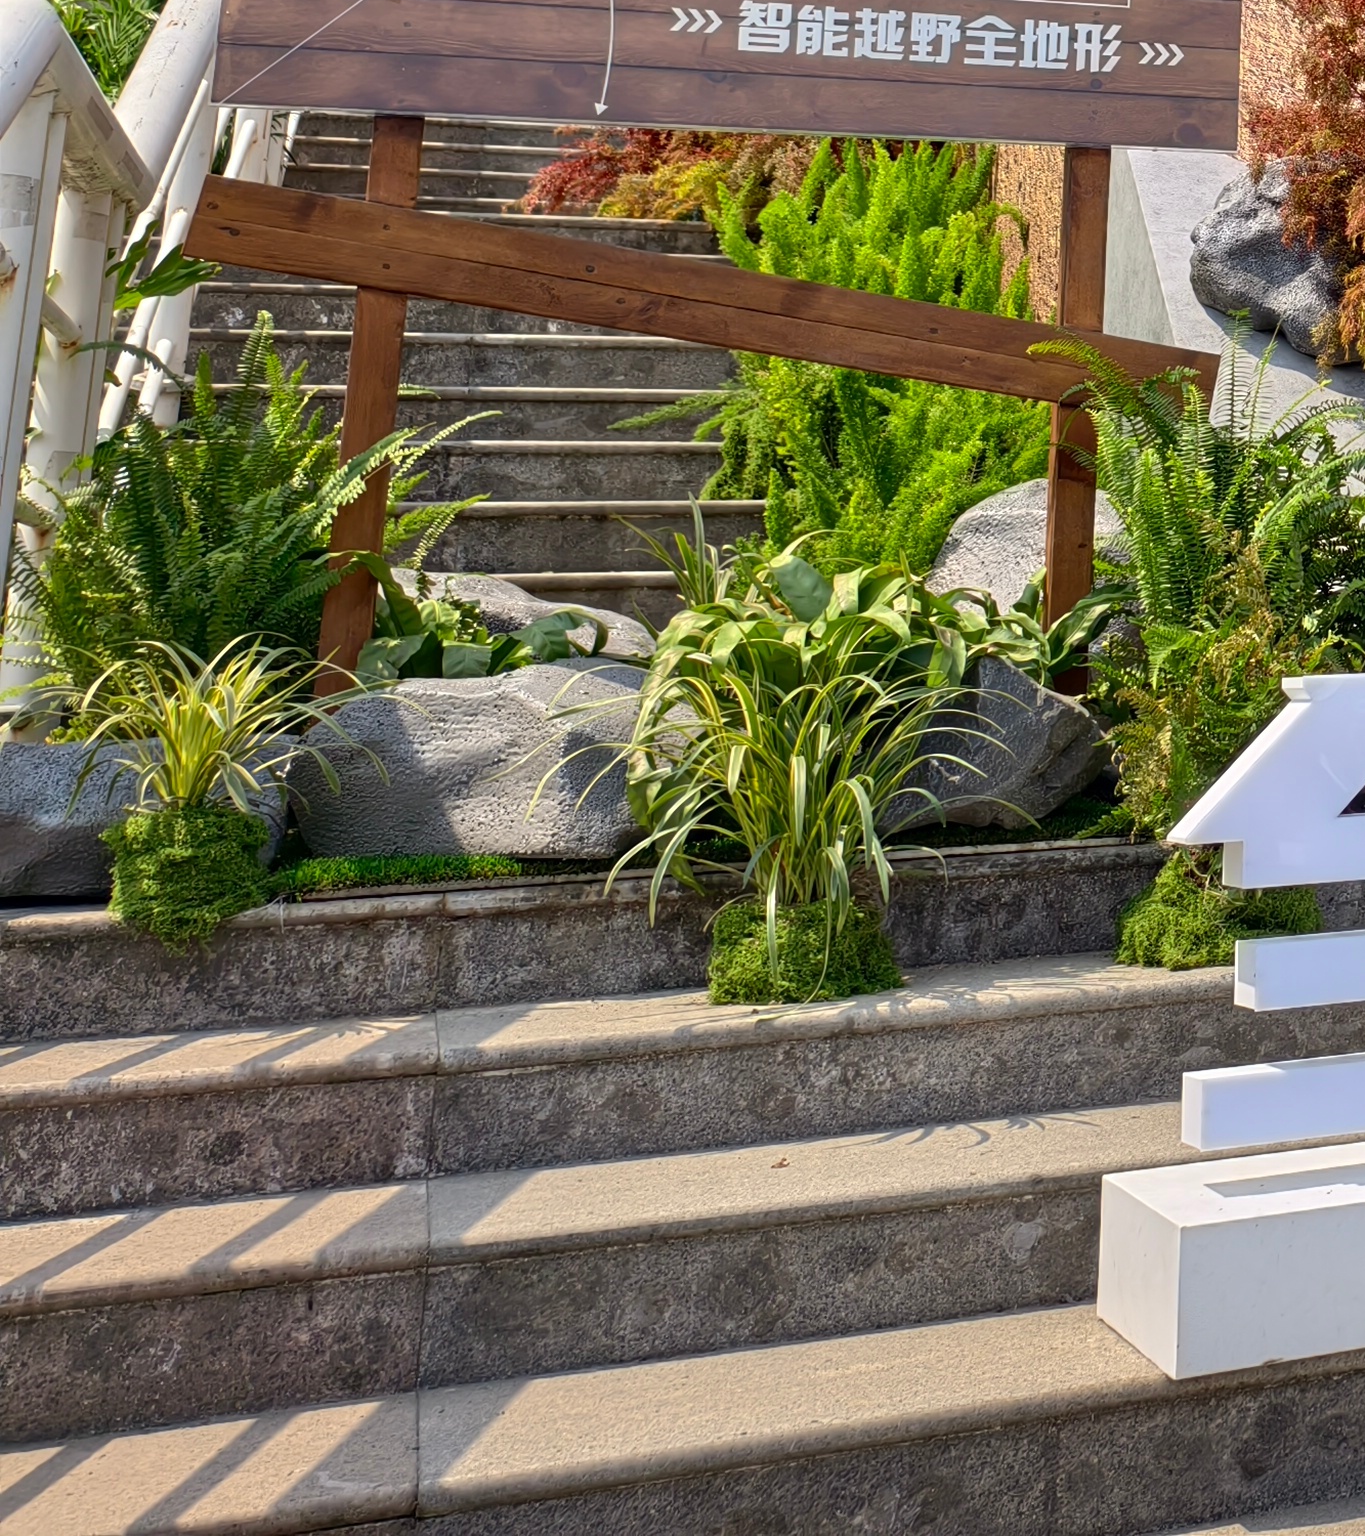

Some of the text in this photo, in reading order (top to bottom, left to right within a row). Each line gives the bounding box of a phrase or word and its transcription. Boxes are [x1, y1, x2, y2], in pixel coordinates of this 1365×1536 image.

[737, 0, 1123, 72] 智能越野全地形
